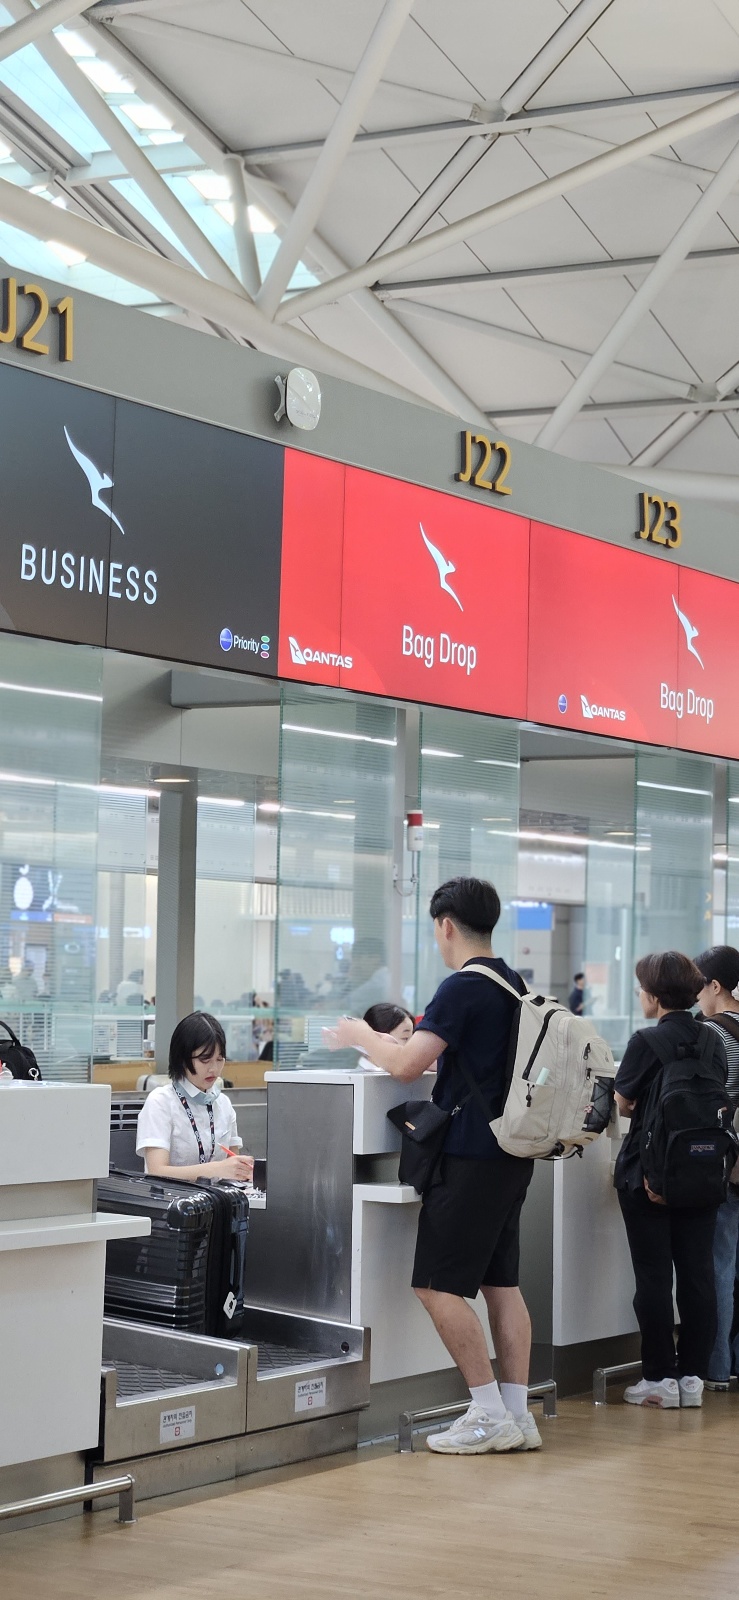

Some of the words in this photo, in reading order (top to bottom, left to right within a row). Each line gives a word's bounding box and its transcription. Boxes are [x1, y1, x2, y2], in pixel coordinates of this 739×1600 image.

[0, 277, 74, 362] J21
[455, 430, 512, 496] J22
[636, 491, 682, 549] J23
[20, 543, 158, 605] BUSINESS
[233, 635, 260, 654] Priority
[303, 647, 353, 669] QANTAS
[402, 625, 434, 668] Bag
[439, 633, 477, 676] Drop
[590, 704, 626, 721] QANTAS
[660, 682, 684, 719] Bag
[687, 688, 714, 725] Drop
